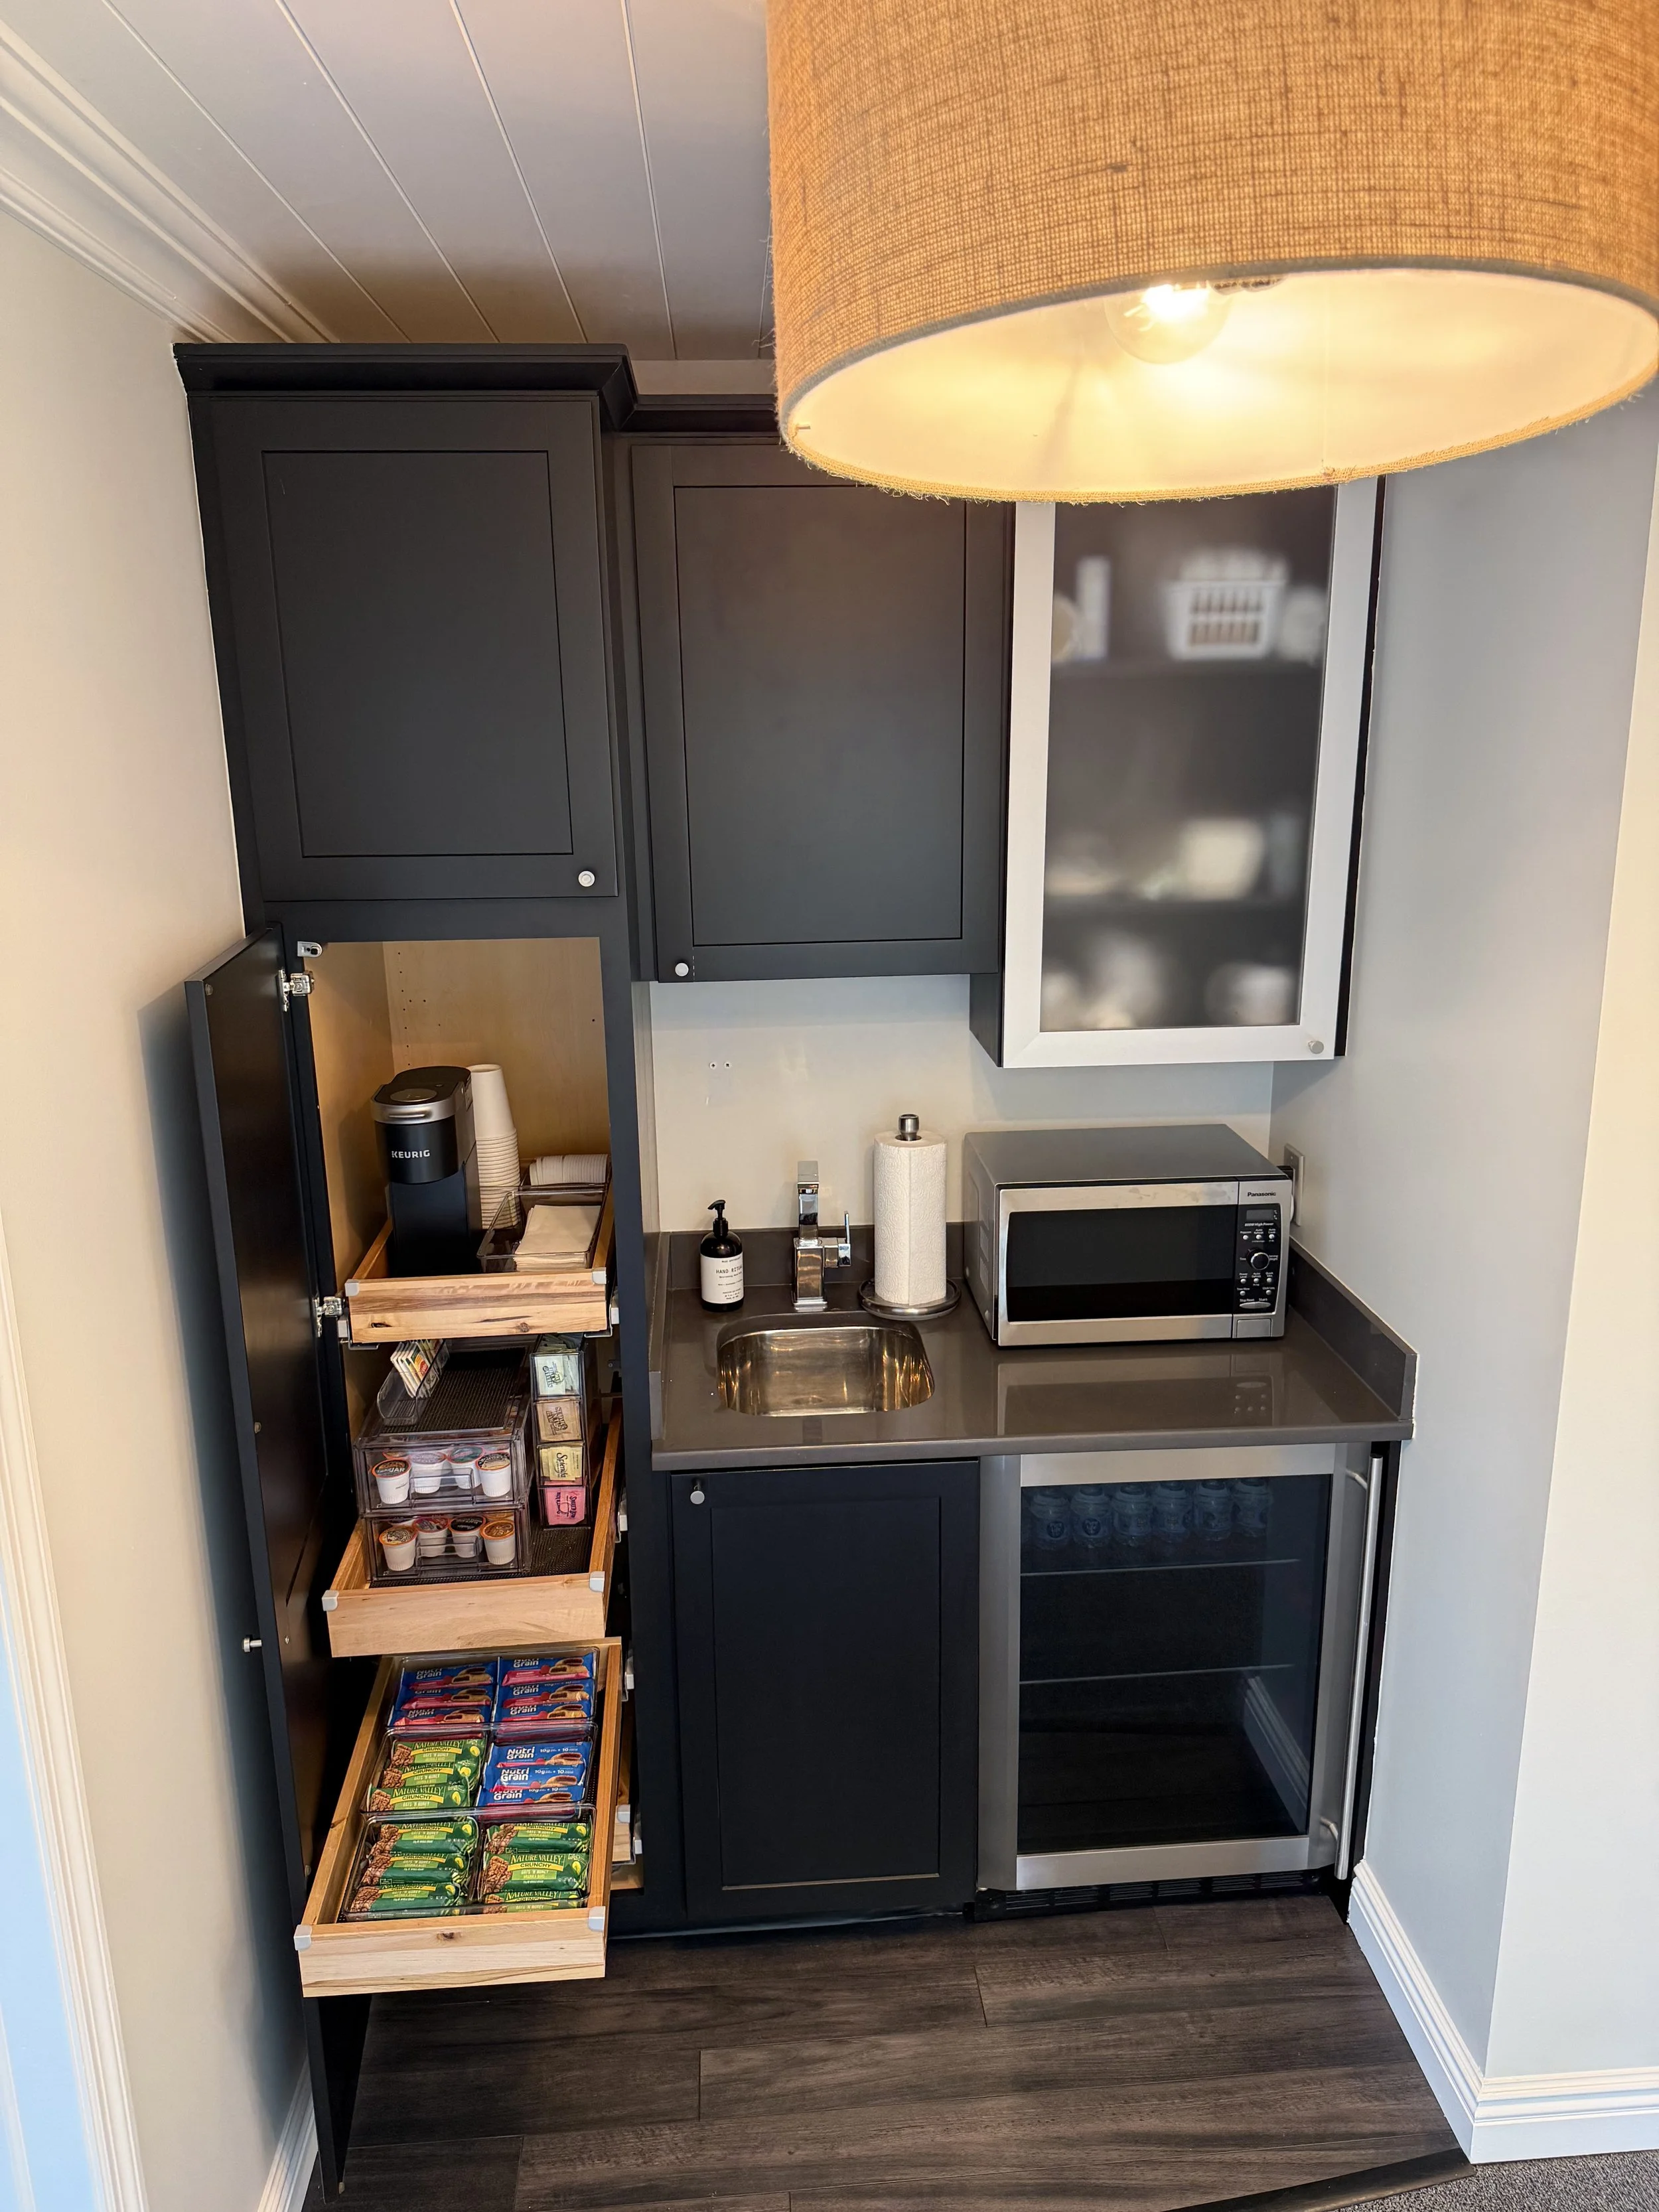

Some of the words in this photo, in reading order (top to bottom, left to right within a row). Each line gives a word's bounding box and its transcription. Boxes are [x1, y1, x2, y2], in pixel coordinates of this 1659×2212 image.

[392, 1149, 430, 1158] KEURIG
[415, 1670, 442, 1680] Grain
[513, 1686, 539, 1696] Grain
[508, 1746, 535, 1755] Nutri
[500, 1773, 529, 1782] Grain
[393, 1788, 419, 1798] NATURE
[420, 1787, 443, 1796] VALLEY
[511, 1854, 538, 1864] NATURE
[539, 1854, 563, 1865] VALLEY
[506, 1891, 534, 1901] NATURE
